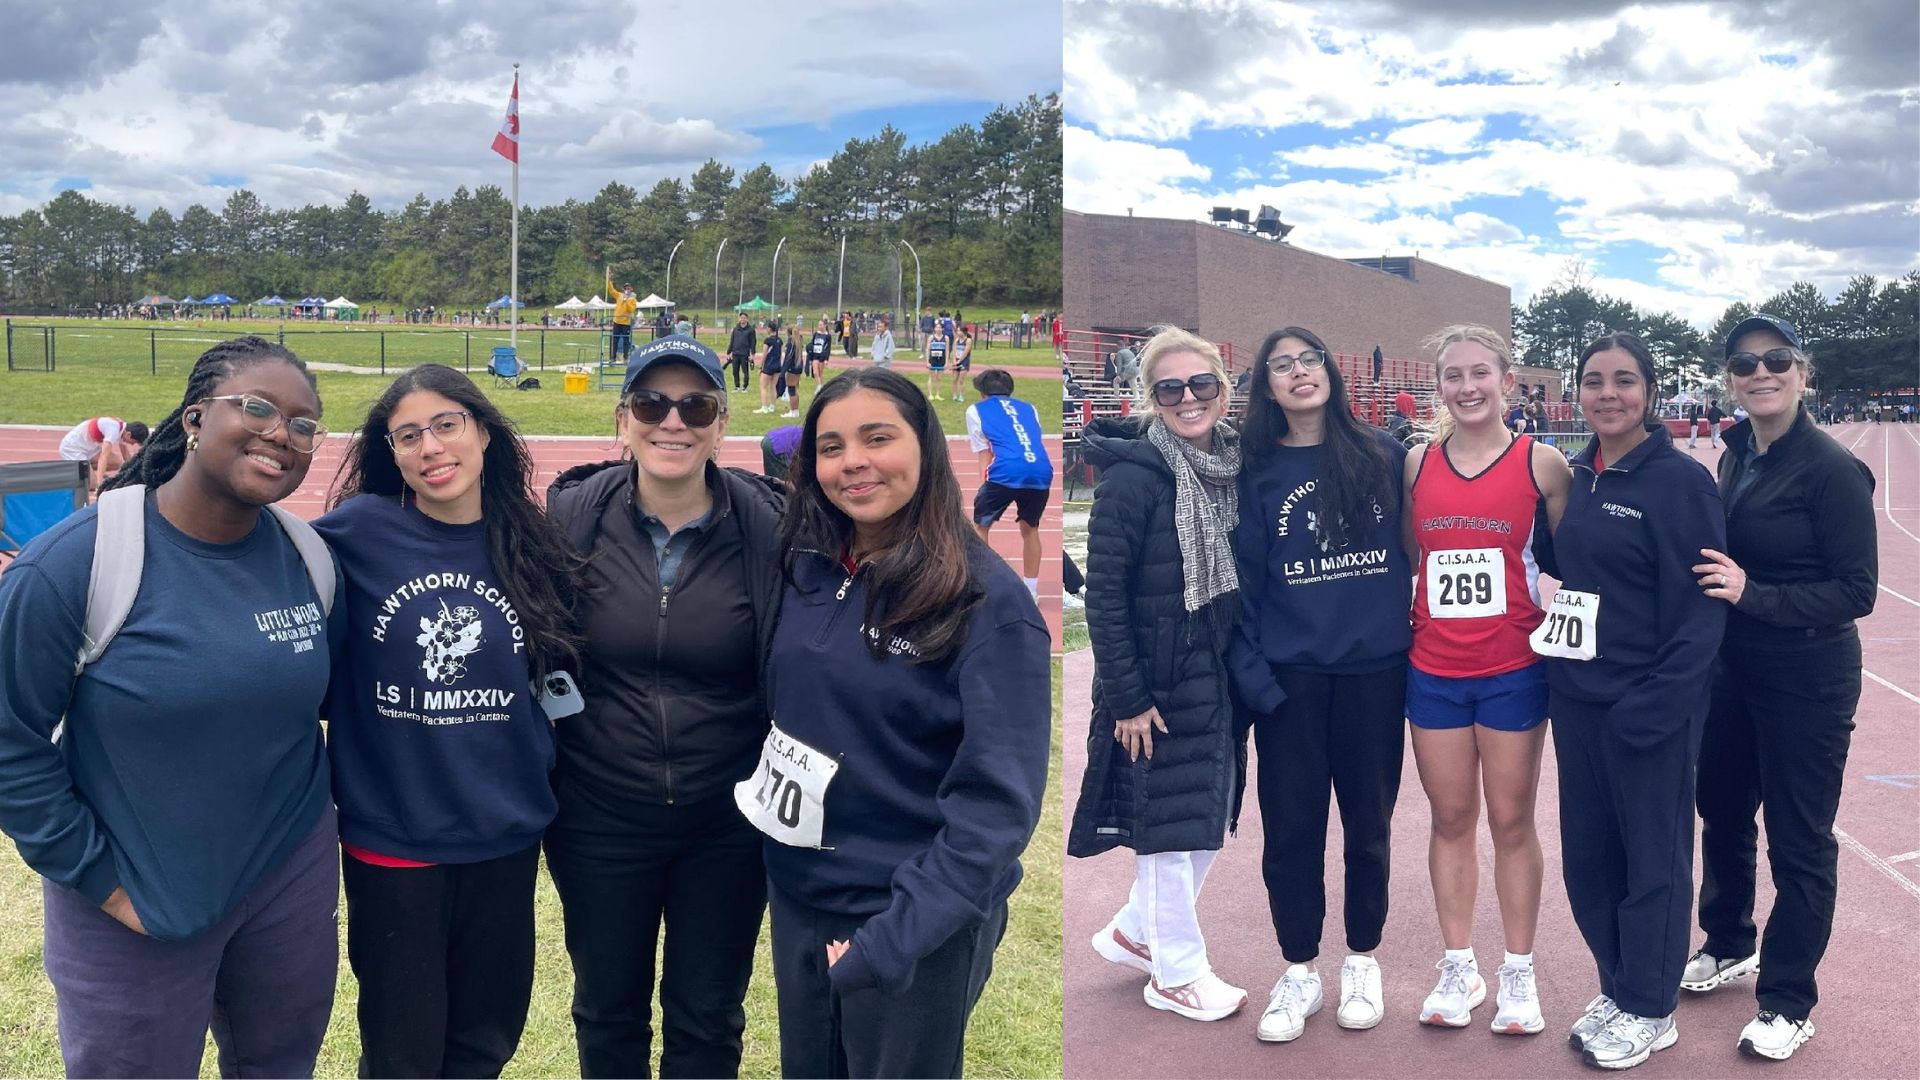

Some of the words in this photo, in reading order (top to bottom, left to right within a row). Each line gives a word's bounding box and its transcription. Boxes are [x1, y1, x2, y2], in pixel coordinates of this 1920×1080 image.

[640, 340, 705, 357] HAWTHORN
[1278, 478, 1319, 537] HAWTHO
[1601, 502, 1643, 519] HAWTHORN
[1422, 516, 1511, 534] HAWTHORN
[1284, 561, 1305, 576] LS
[1321, 549, 1387, 571] MMXXIV
[1437, 553, 1491, 565] C.I.S.A.A.
[1439, 572, 1492, 605] 269
[254, 609, 293, 632] LITTLE
[373, 573, 470, 642] HAWTHORN
[473, 580, 525, 654] SCHOOL
[1542, 612, 1583, 648] 270
[376, 681, 400, 704] LS
[423, 689, 515, 710] MMXXIV
[376, 704, 421, 721] Veritatem
[422, 714, 463, 725] Facientes
[465, 713, 475, 722] in
[475, 711, 510, 722] Caritate
